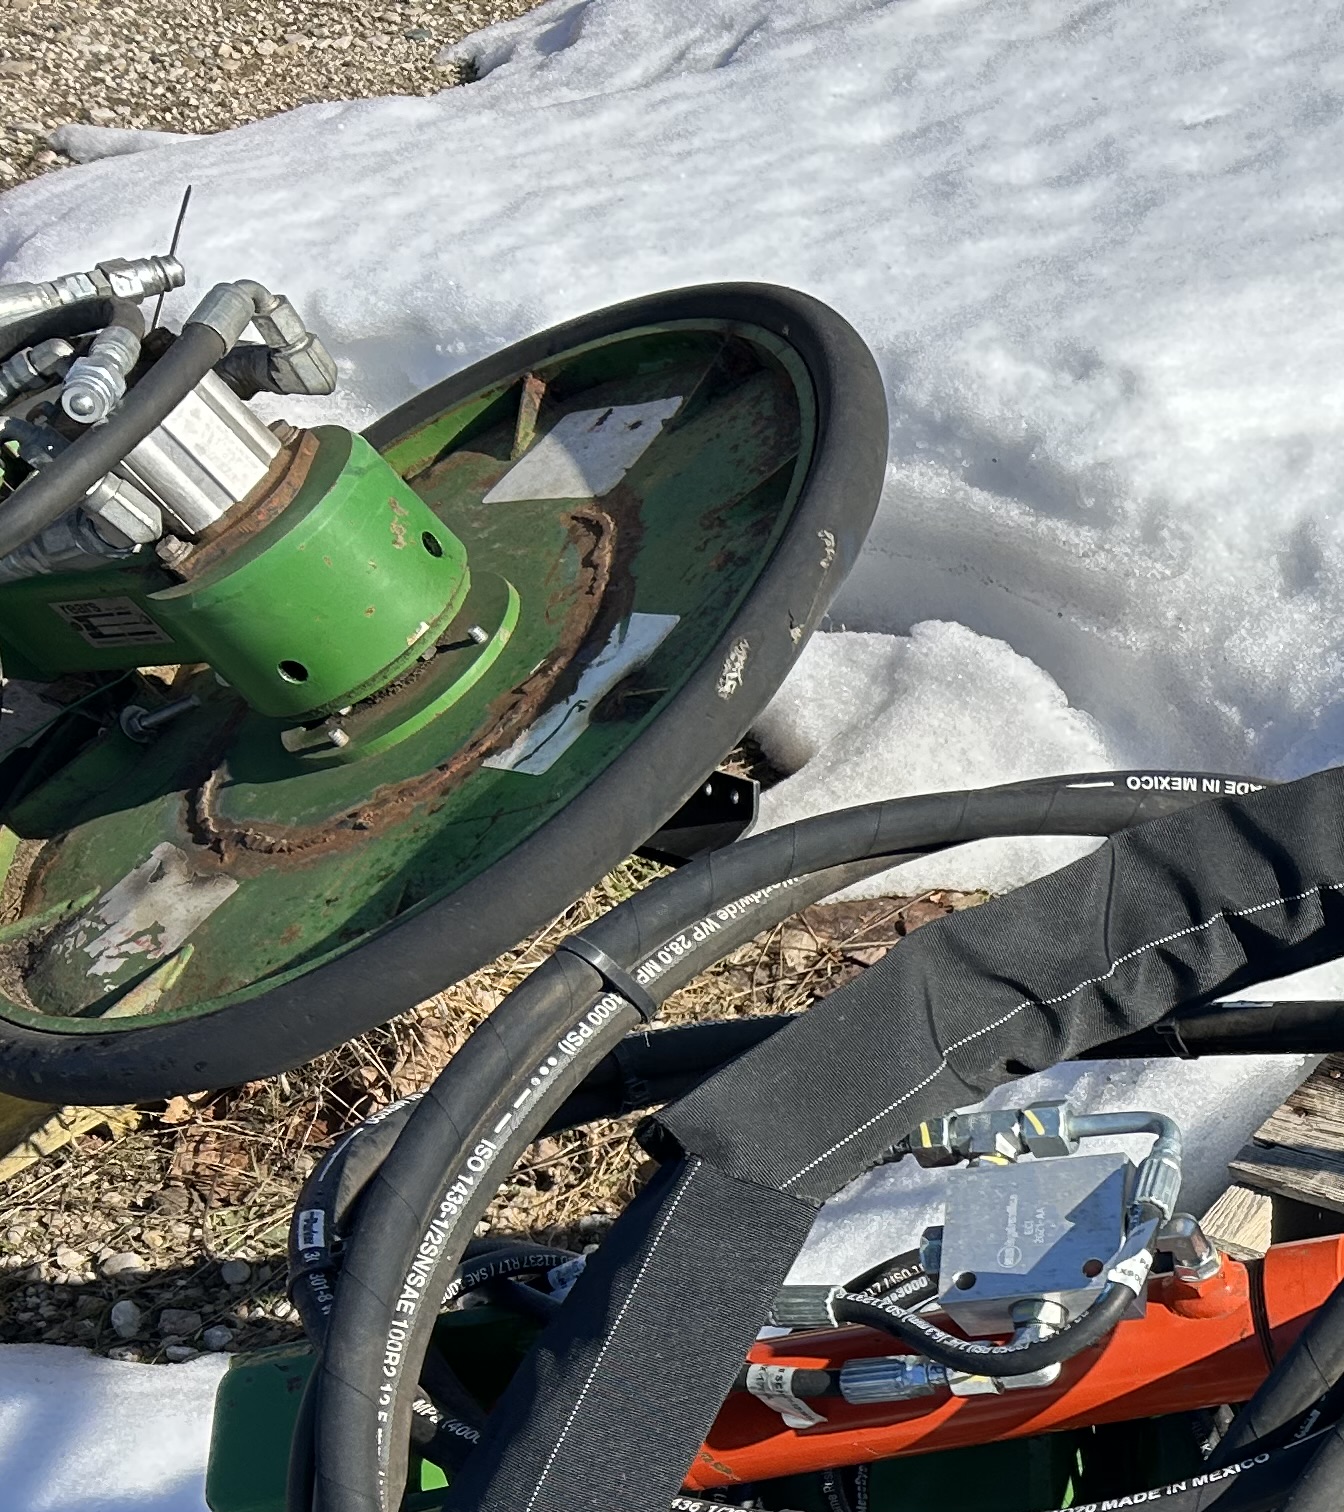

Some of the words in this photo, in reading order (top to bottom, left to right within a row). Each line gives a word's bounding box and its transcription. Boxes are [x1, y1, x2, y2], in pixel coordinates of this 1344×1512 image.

[58, 598, 102, 616] rears
[1126, 776, 1197, 791] MEXICO
[1202, 779, 1220, 792] IN
[1224, 780, 1266, 795] ADE
[692, 918, 722, 942] WP
[659, 934, 692, 965] 28,0
[636, 962, 663, 986] MP
[557, 1025, 594, 1055] PSI)
[466, 1139, 497, 1174] ISO
[395, 1172, 475, 1316] 1436-1/2SN/SAE
[498, 1256, 520, 1273] R17
[522, 1254, 557, 1268] 11237
[465, 1268, 488, 1285] SAE
[442, 1418, 480, 1444] (400
[672, 1497, 702, 1512] 436
[1101, 1488, 1161, 1512] MADE
[1166, 1481, 1187, 1496] IN
[1192, 1453, 1271, 1487] MEXICO
